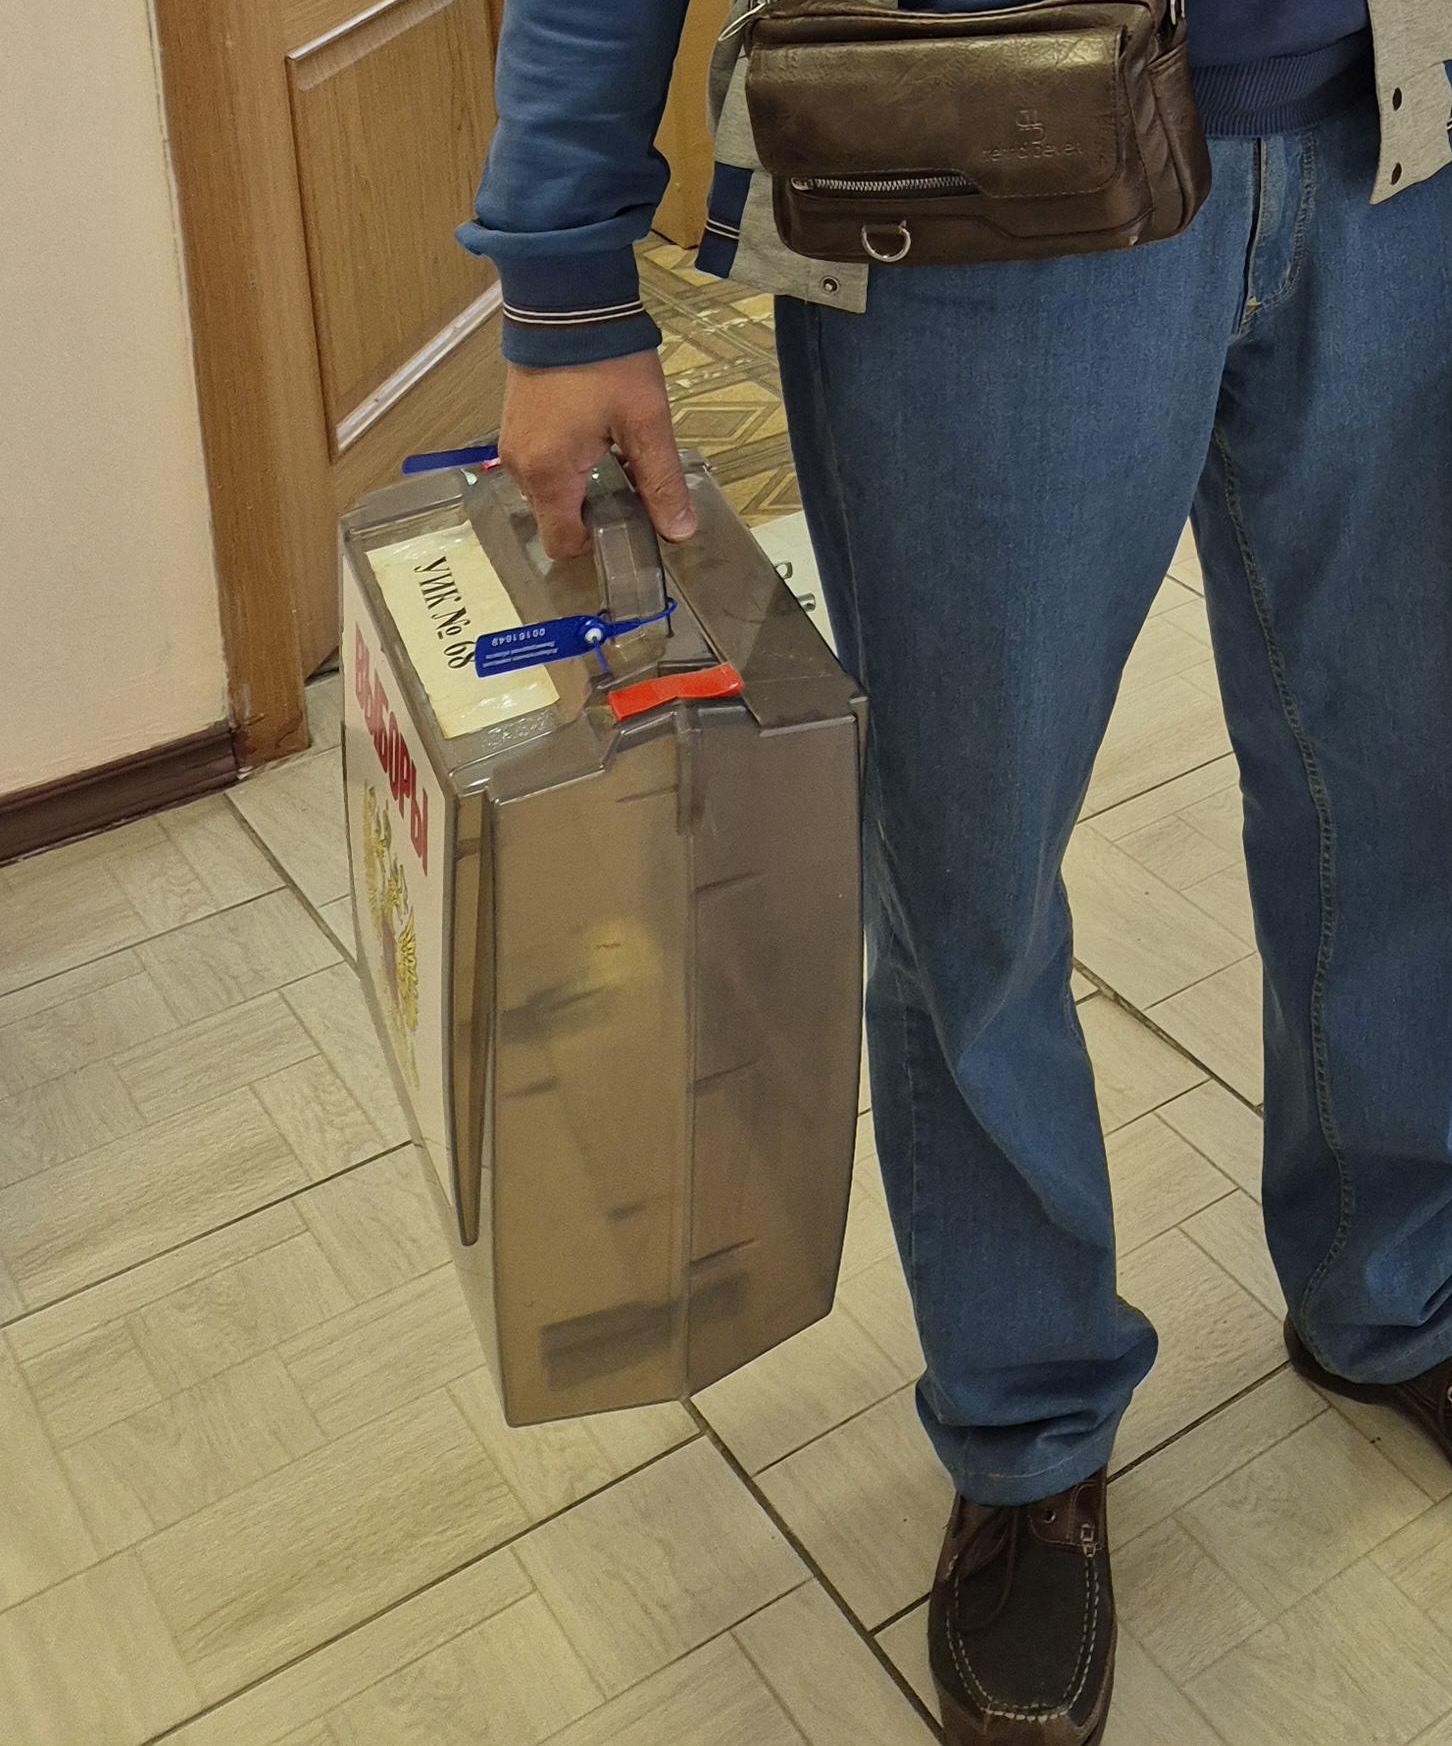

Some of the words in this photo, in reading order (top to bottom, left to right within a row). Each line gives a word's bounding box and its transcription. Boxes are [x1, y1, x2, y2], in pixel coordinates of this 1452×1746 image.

[413, 555, 462, 610] УИК
[430, 606, 471, 640] №
[443, 640, 477, 670] 68
[355, 621, 428, 878] ВЫБОРЫ
